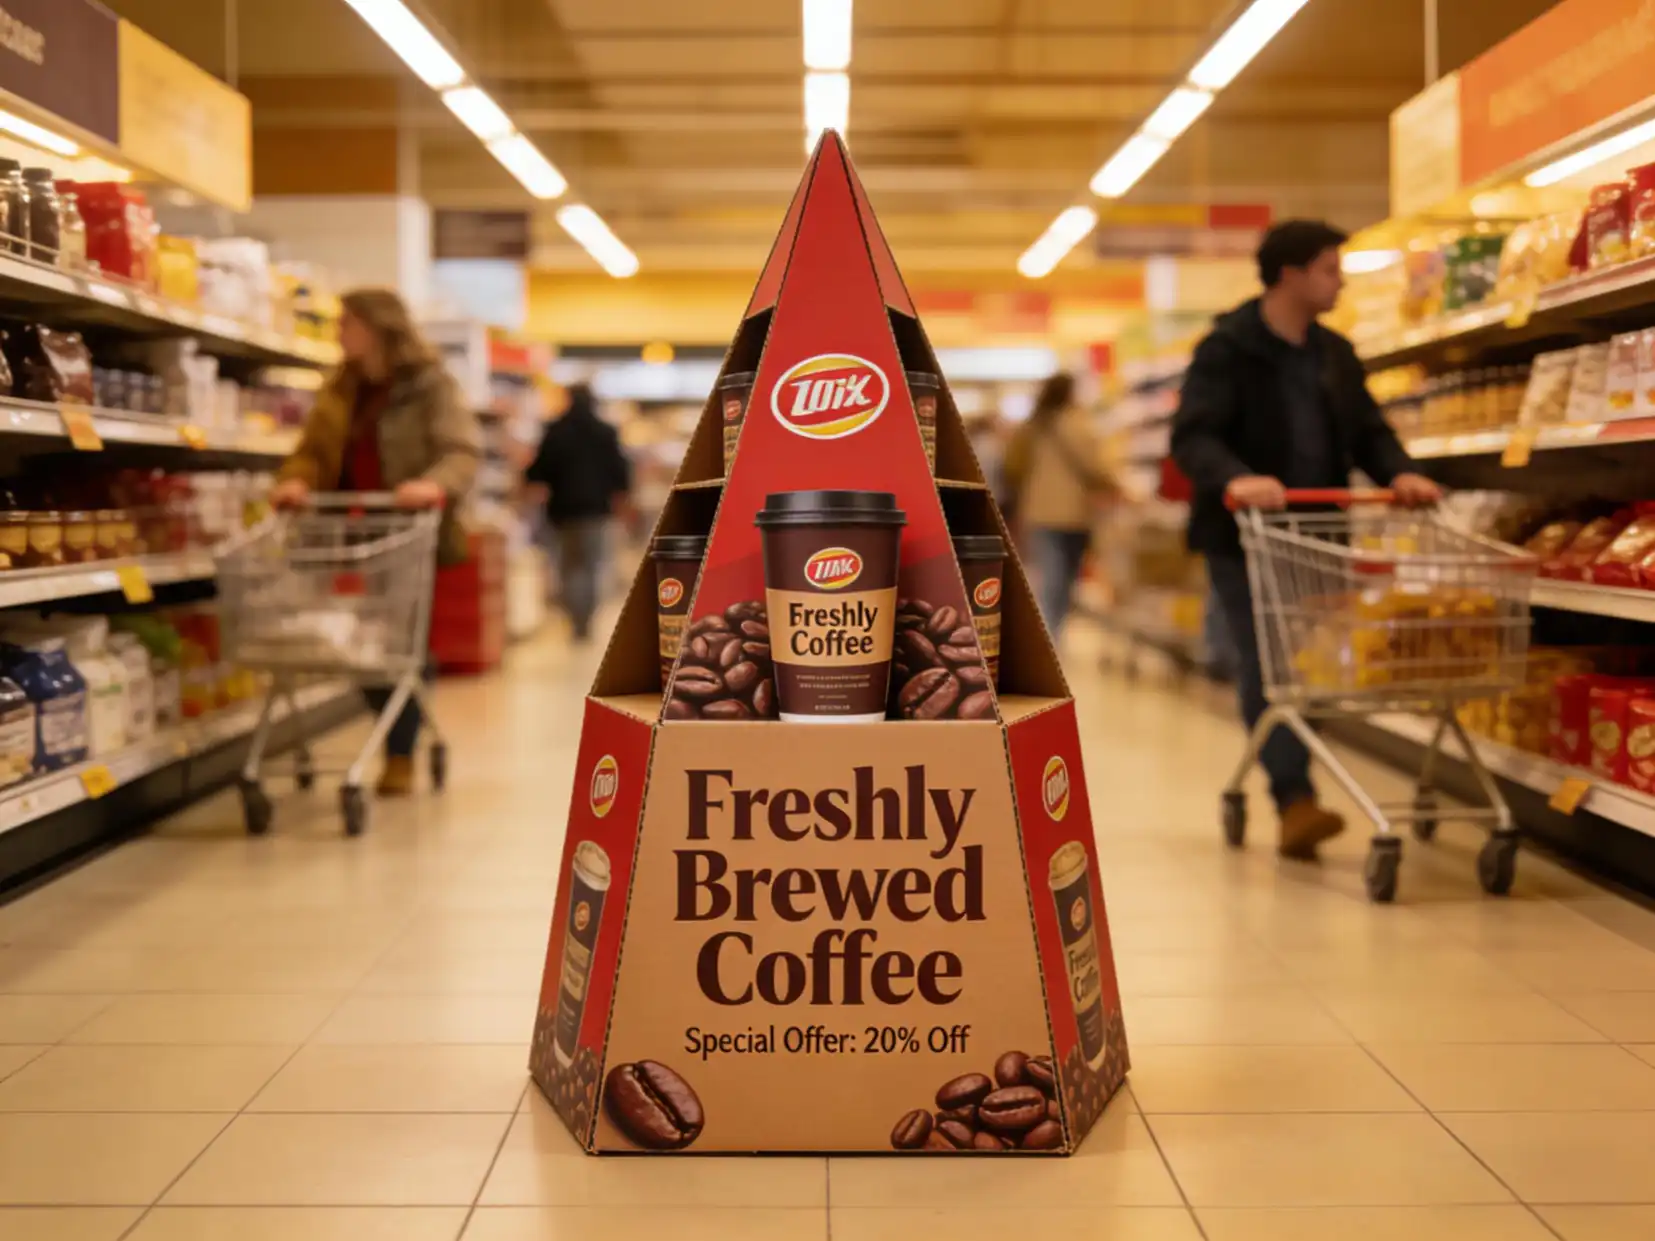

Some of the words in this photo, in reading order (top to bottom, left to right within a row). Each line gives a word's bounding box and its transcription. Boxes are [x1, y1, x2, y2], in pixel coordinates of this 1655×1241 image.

[788, 601, 878, 633] Freshly
[790, 629, 874, 656] Coffee
[684, 764, 977, 860] Freshly
[673, 844, 987, 923] Brewed
[696, 929, 963, 1006] Coffee
[684, 1025, 776, 1062] Special
[783, 1025, 857, 1054] Offer:
[863, 1026, 921, 1054] 20%
[927, 1025, 972, 1054] Off
